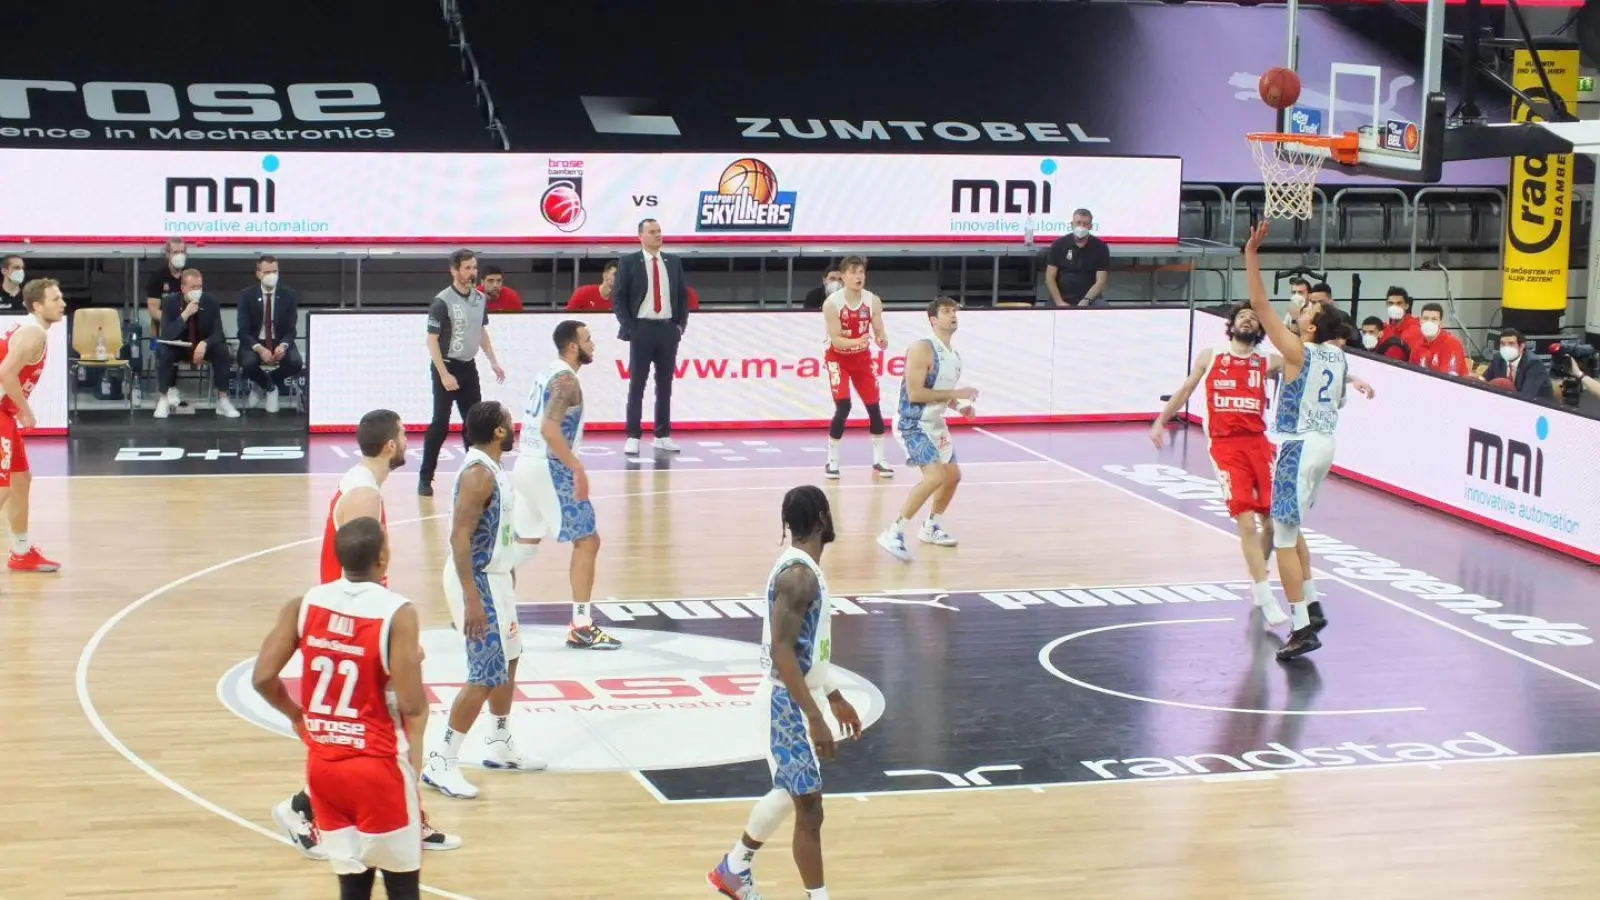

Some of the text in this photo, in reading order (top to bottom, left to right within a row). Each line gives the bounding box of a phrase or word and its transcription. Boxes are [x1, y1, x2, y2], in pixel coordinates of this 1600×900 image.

[0, 126, 396, 140] ence in Mechatronics
[735, 117, 1111, 143] ZUMTOBEL
[547, 168, 583, 176] bamberg
[548, 157, 584, 168] brose
[700, 187, 791, 225] SKYLINERS
[164, 218, 329, 232] innovative automation
[950, 218, 1020, 232] innovative
[1317, 369, 1334, 403] 2
[114, 446, 305, 461] D+S
[1464, 482, 1580, 536] innovative automation
[979, 584, 1244, 610] PUMA
[309, 655, 360, 719] 22
[570, 699, 754, 713] Mechatro
[303, 714, 365, 737] brose
[1079, 731, 1519, 780] randstad
